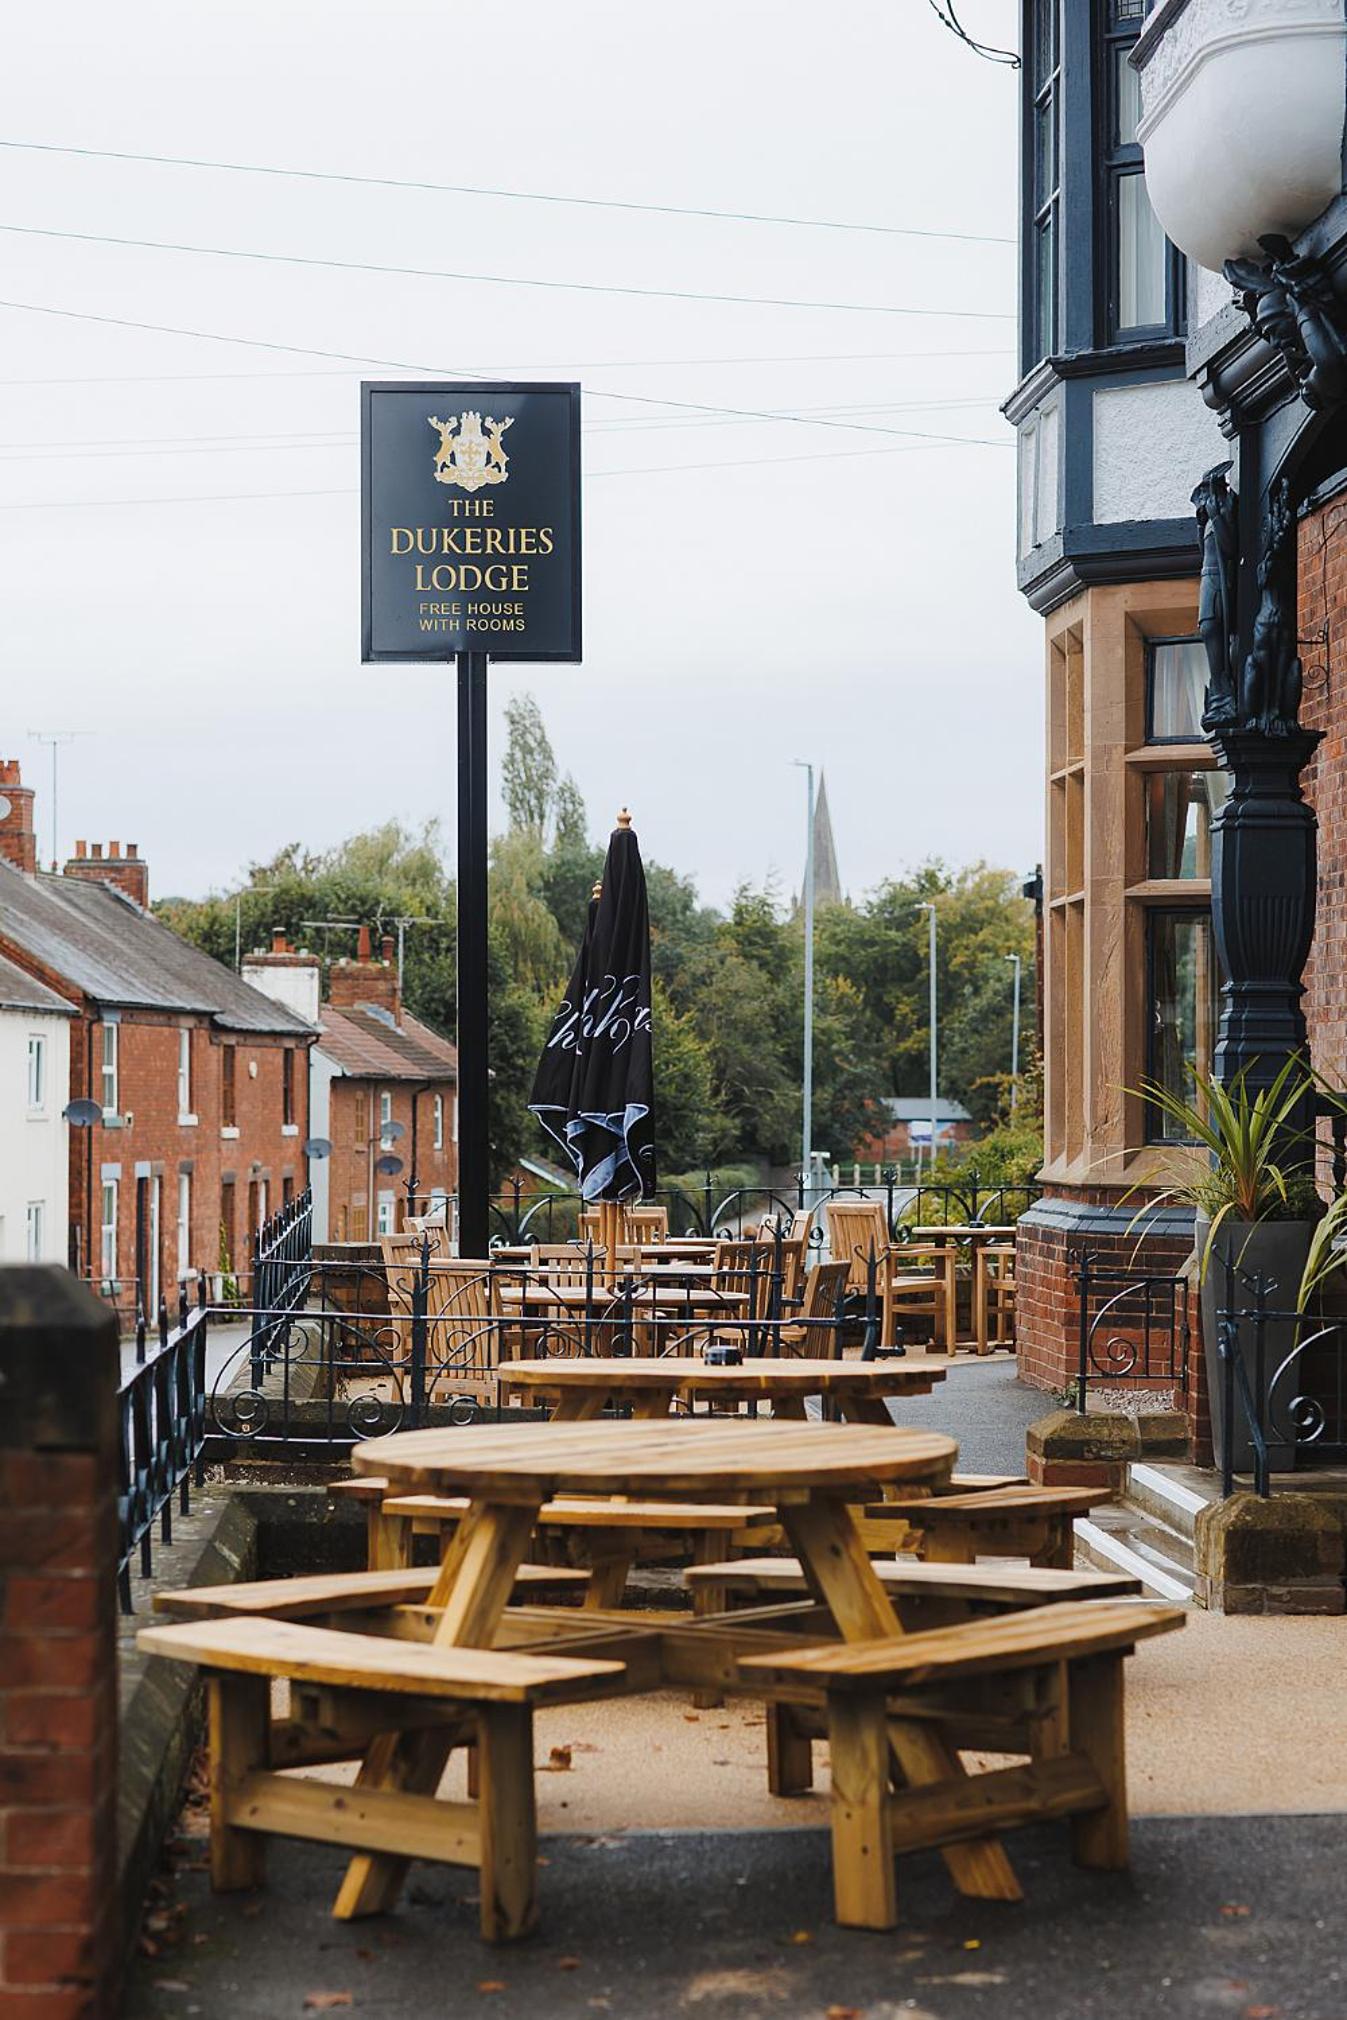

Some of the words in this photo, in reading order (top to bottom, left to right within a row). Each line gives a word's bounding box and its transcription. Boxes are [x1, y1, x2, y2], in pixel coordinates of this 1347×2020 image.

[448, 500, 494, 517] THE
[390, 527, 554, 554] DUKERIES
[415, 565, 529, 591] LODGE
[419, 602, 461, 615] FREE
[468, 602, 524, 615] HOUSE
[419, 619, 460, 631] WITH
[466, 619, 525, 631] ROOMS
